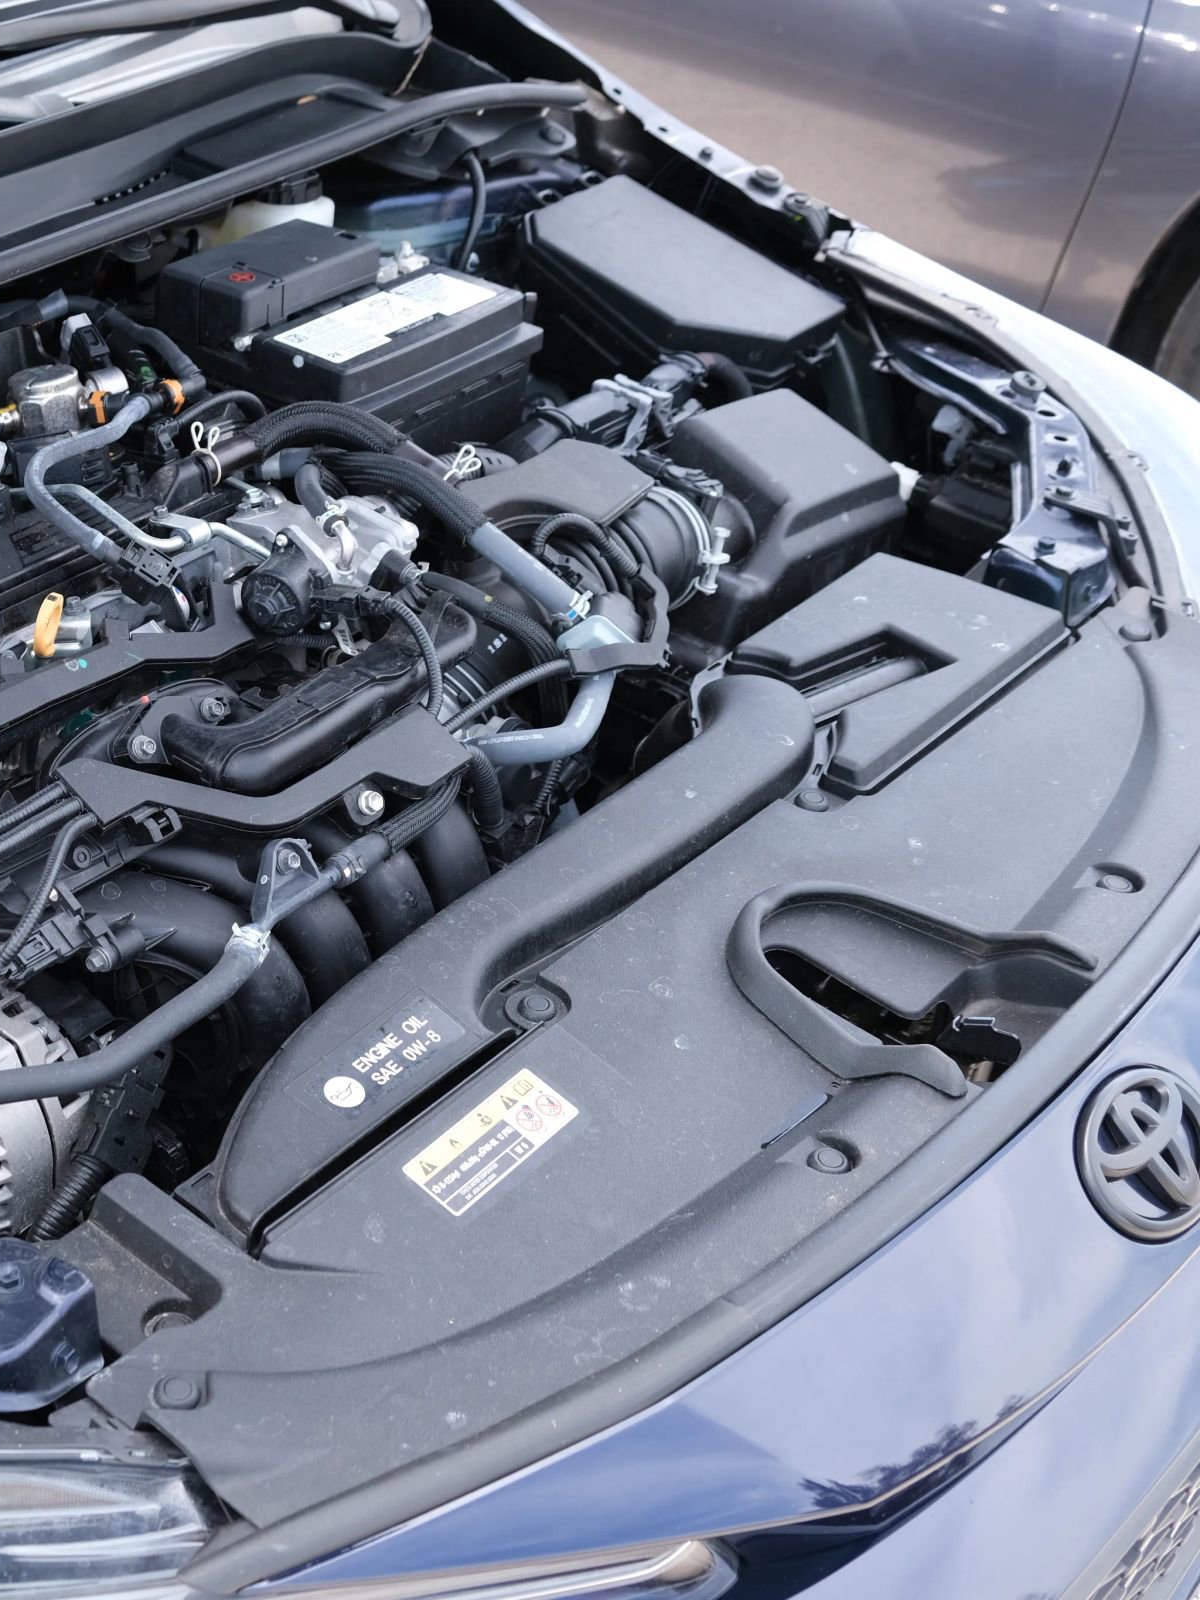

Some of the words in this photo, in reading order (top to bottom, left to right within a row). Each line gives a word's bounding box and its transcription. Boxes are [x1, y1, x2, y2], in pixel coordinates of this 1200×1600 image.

[352, 1032, 403, 1073] ENGINE
[402, 1015, 429, 1034] OIL
[370, 1059, 404, 1085] SAE
[402, 1029, 441, 1061] 0W-8
